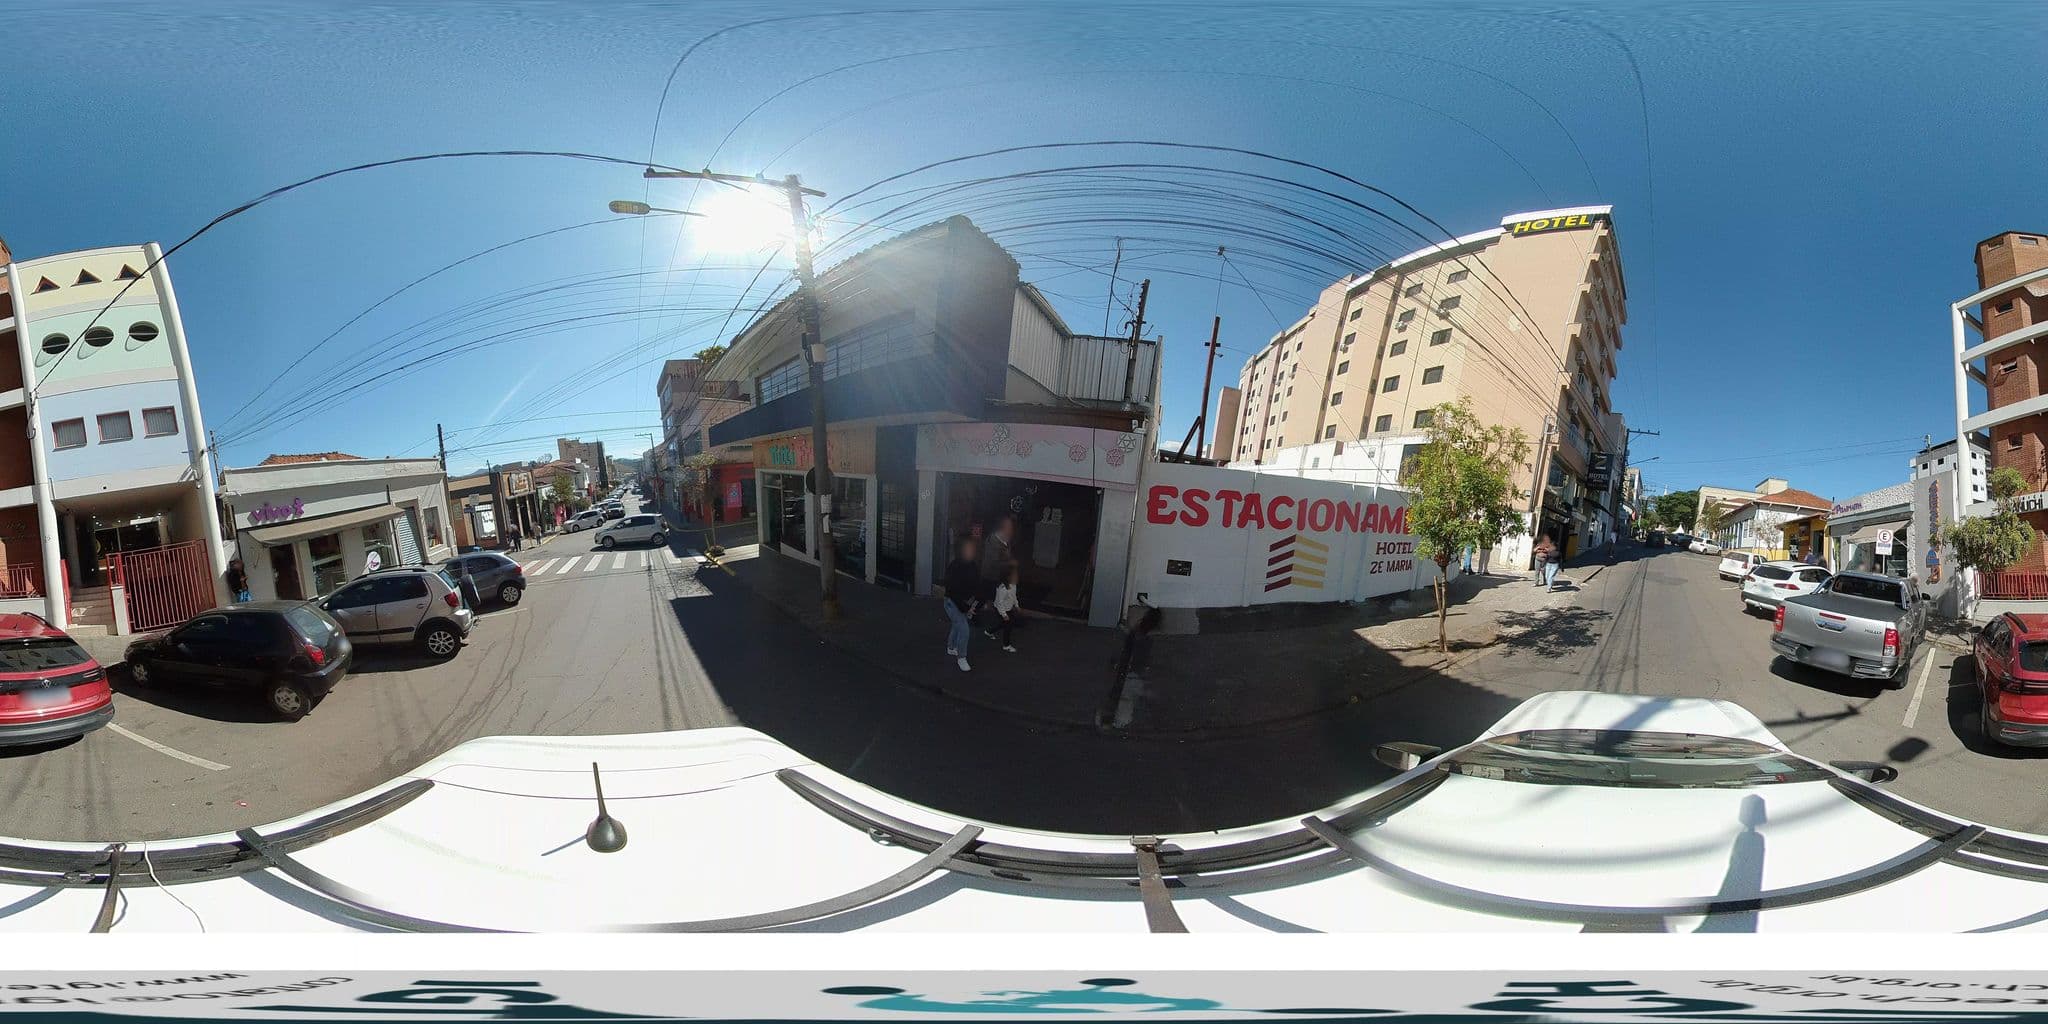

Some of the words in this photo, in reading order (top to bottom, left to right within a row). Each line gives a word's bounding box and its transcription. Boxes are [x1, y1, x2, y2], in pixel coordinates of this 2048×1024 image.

[1513, 215, 1590, 233] HOTEL
[247, 502, 292, 525] vivo
[1882, 532, 1888, 541] E
[1375, 541, 1414, 555] HOTEL
[1369, 561, 1385, 575] ZE
[1386, 559, 1412, 573] MARIA
